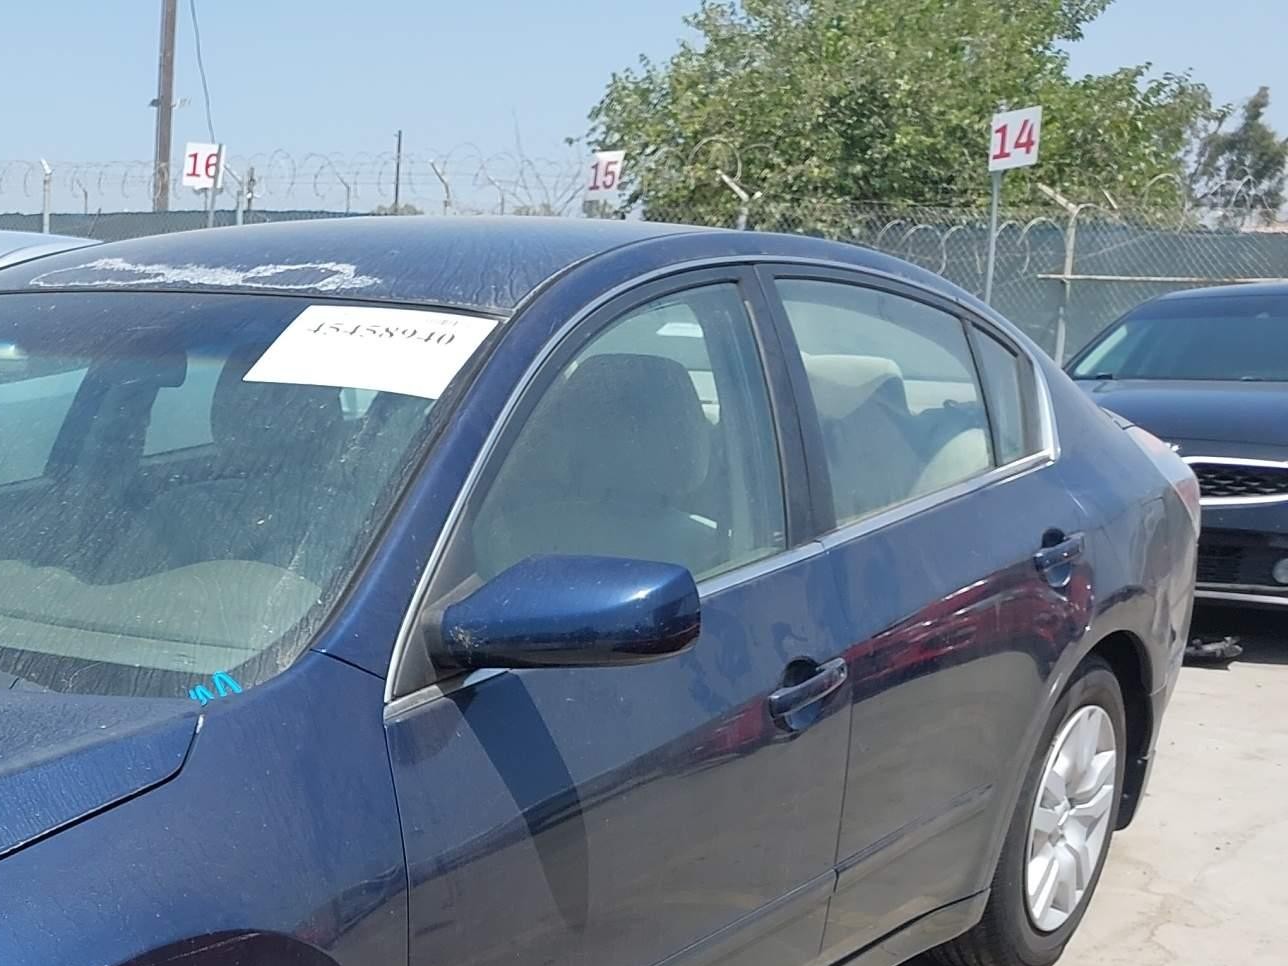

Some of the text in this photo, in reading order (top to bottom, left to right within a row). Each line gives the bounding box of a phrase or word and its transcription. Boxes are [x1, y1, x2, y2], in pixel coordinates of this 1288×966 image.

[992, 119, 1034, 159] 14
[186, 152, 217, 178] 16
[589, 160, 616, 190] 15
